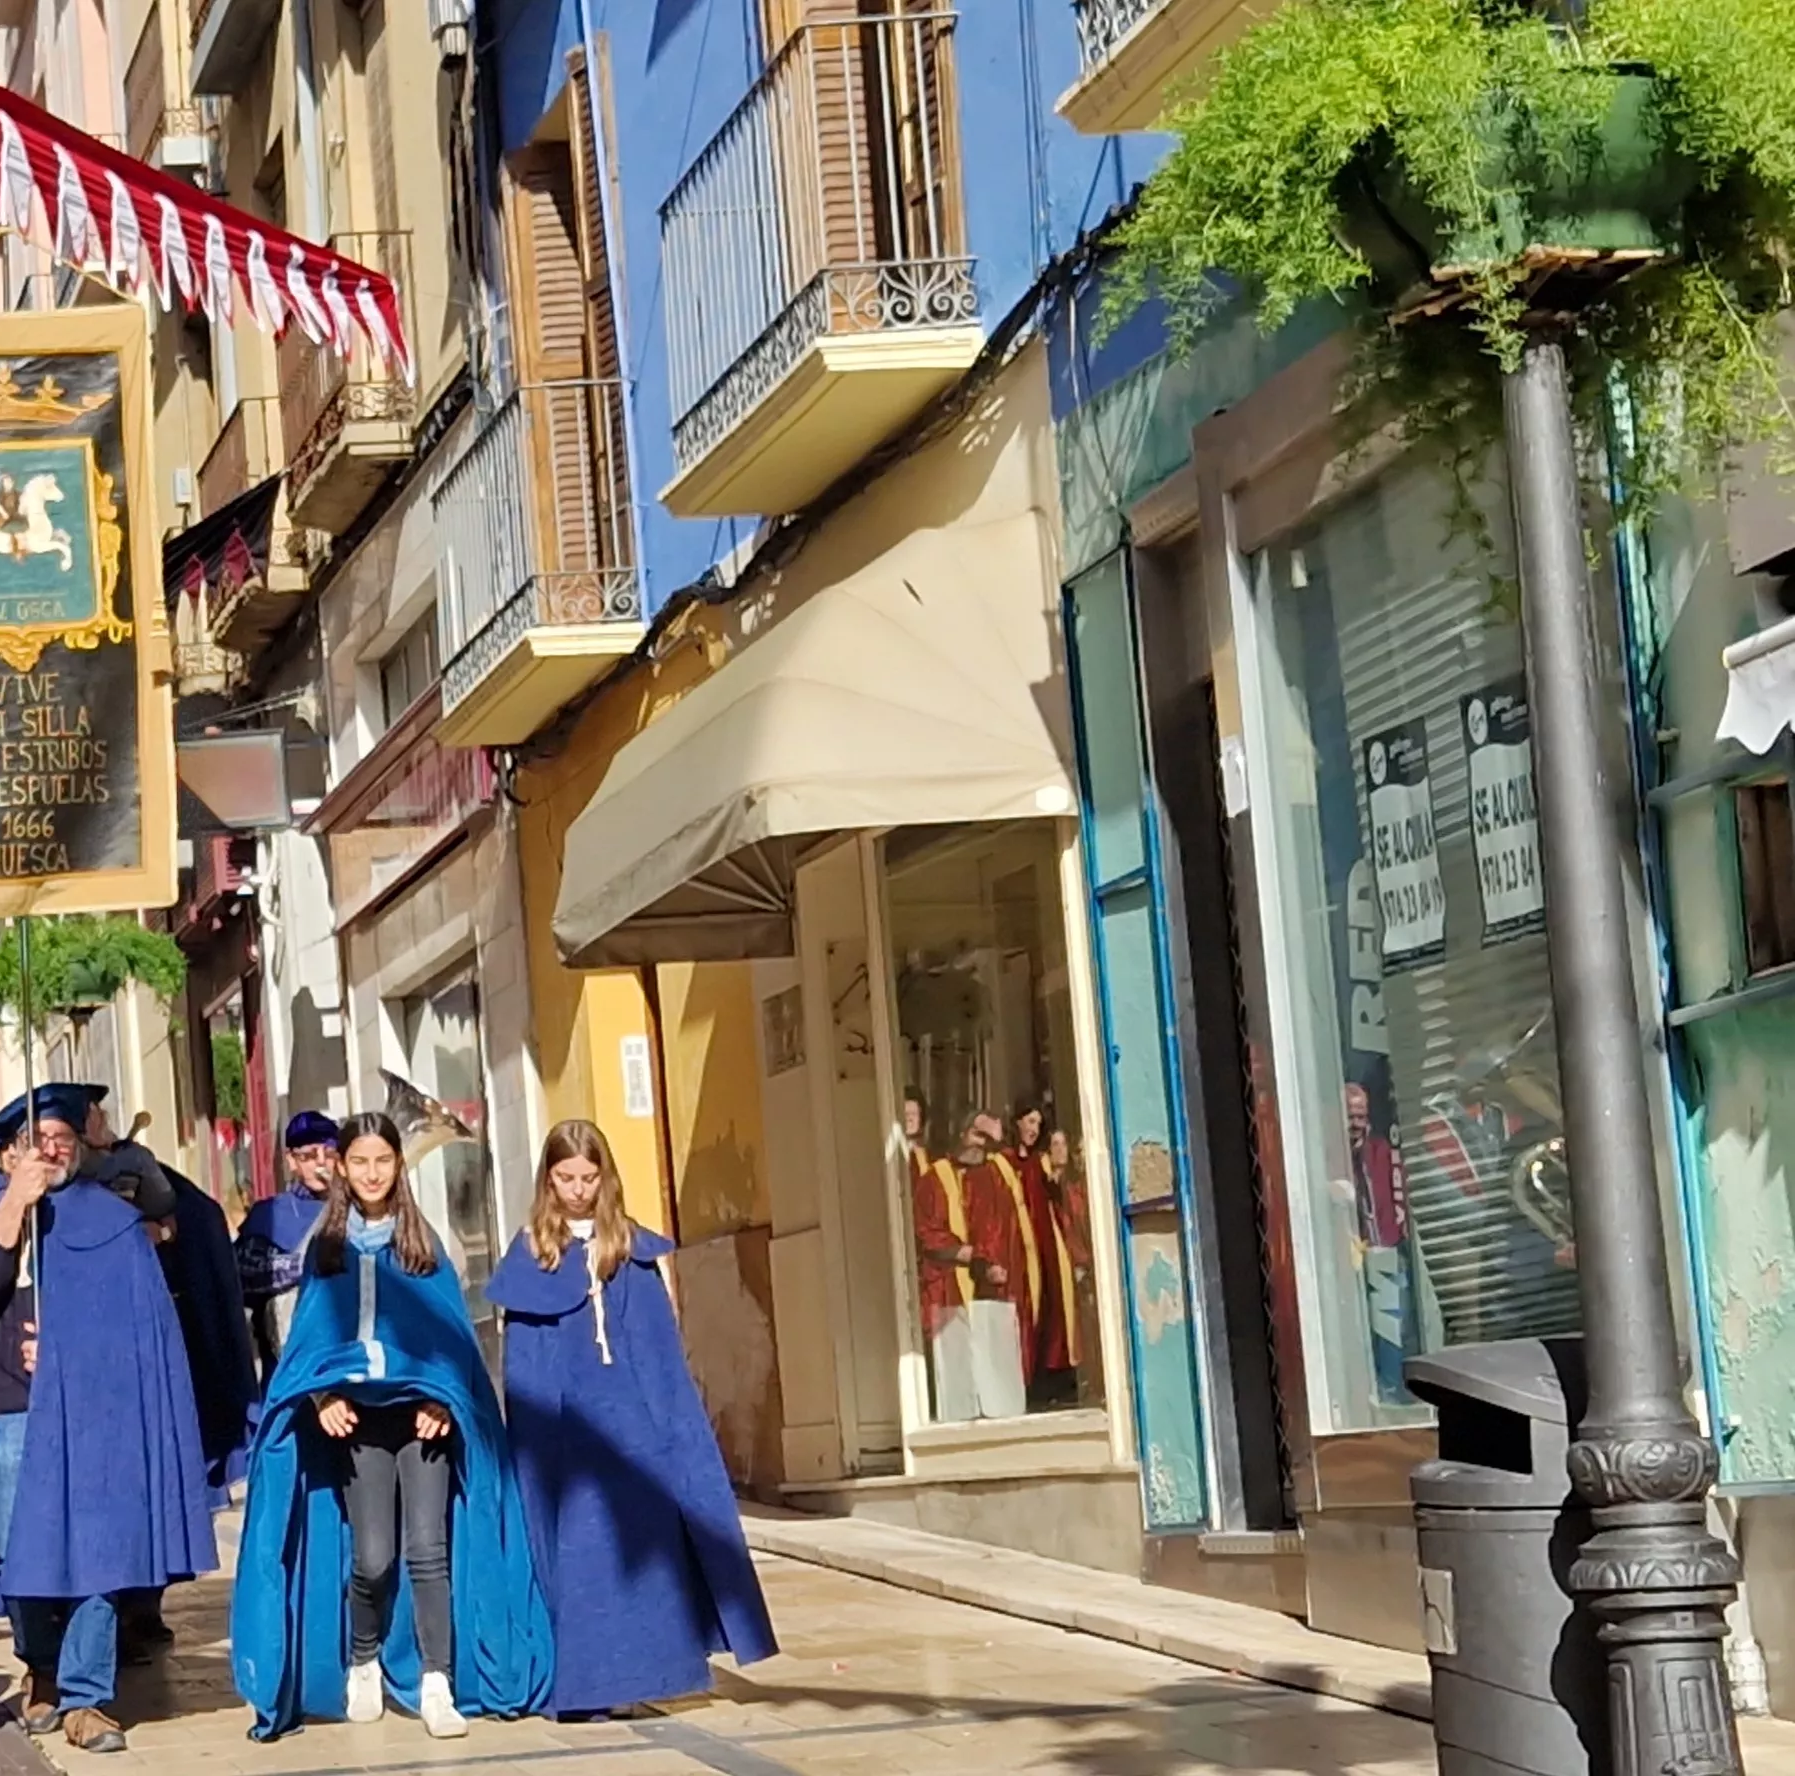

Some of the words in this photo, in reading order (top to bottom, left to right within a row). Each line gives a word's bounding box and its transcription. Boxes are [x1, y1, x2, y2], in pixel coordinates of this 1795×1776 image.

[21, 706, 92, 738] SILLA
[2, 740, 108, 774] ESTRIBOS
[1, 810, 55, 840] 1666
[1474, 787, 1491, 837] SE
[1375, 824, 1393, 872] SE
[1482, 854, 1504, 897] 974
[1503, 849, 1518, 893] 23
[1384, 886, 1406, 929] 974
[1403, 883, 1418, 924] 23
